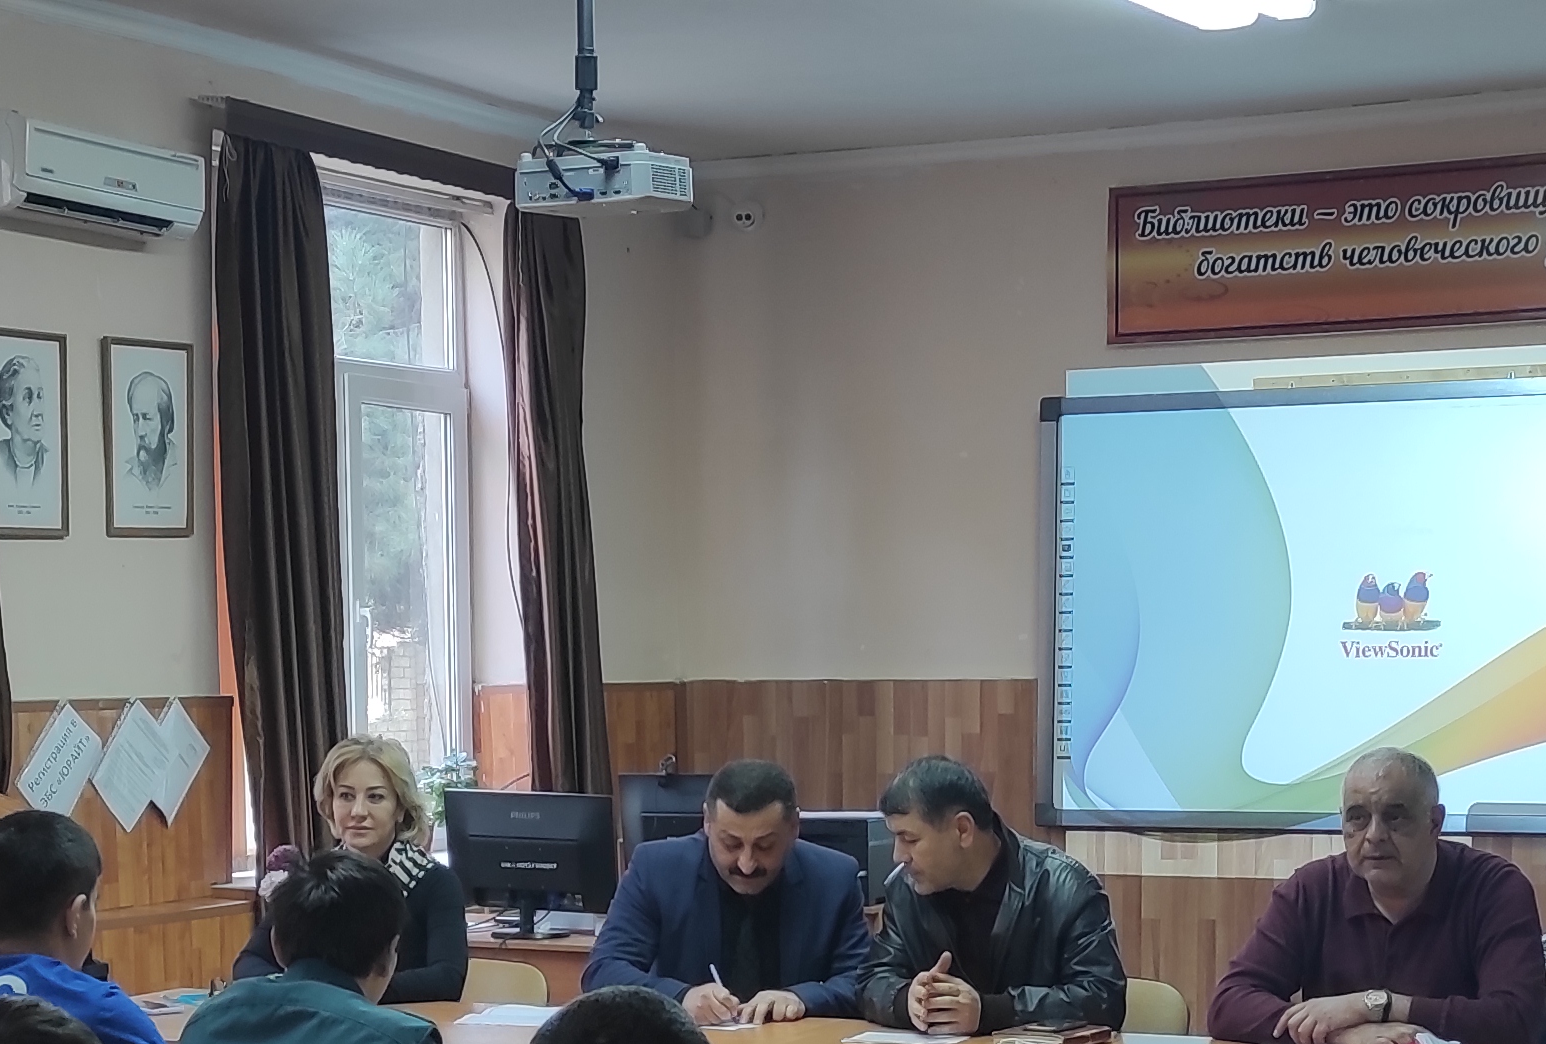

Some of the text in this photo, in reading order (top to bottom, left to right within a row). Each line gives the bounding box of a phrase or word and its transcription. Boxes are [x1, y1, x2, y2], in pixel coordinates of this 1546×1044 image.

[1136, 204, 1308, 239] Библиотеки
[1343, 198, 1400, 226] это
[1194, 240, 1333, 278] богатств
[1341, 232, 1540, 268] человеческого
[1340, 640, 1440, 659] ViewSonic
